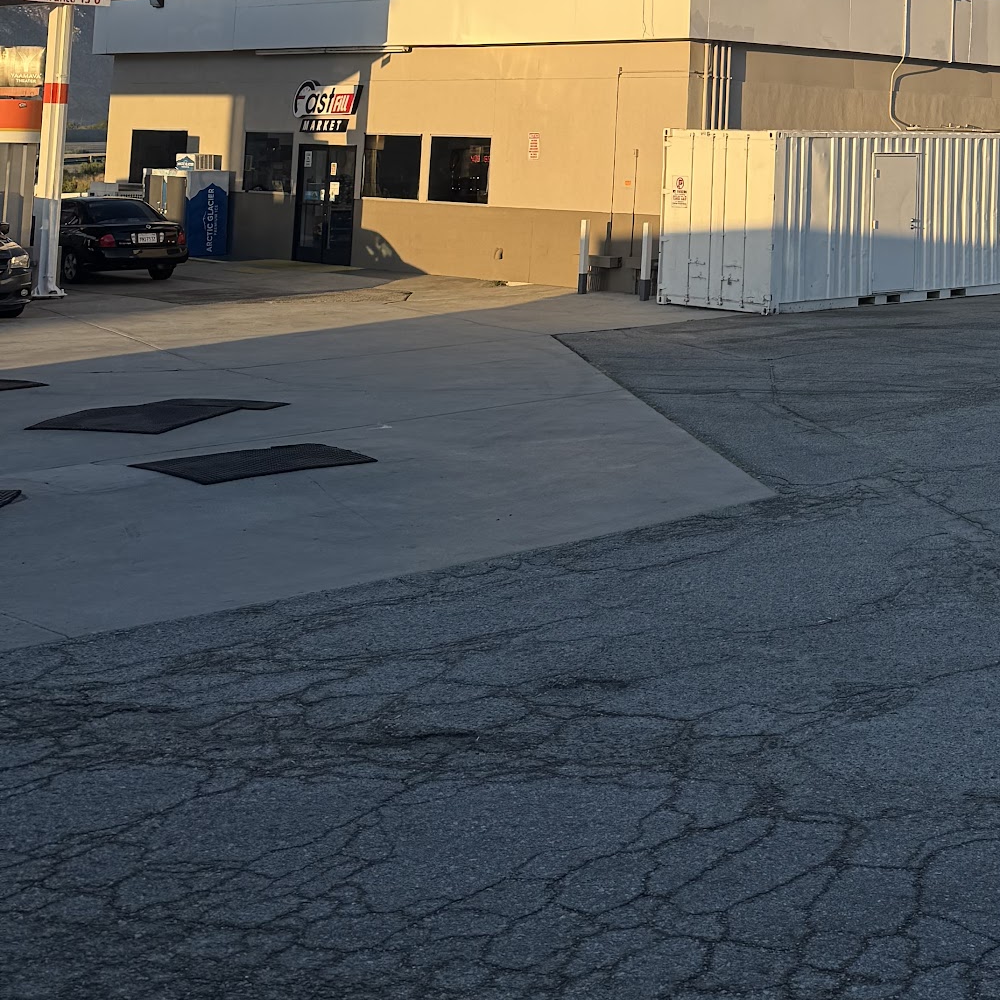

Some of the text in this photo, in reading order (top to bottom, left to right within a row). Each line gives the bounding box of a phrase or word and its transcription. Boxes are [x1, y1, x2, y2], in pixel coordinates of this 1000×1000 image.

[302, 120, 342, 131] MARKET
[206, 188, 215, 252] ARCTIC GLACIER
